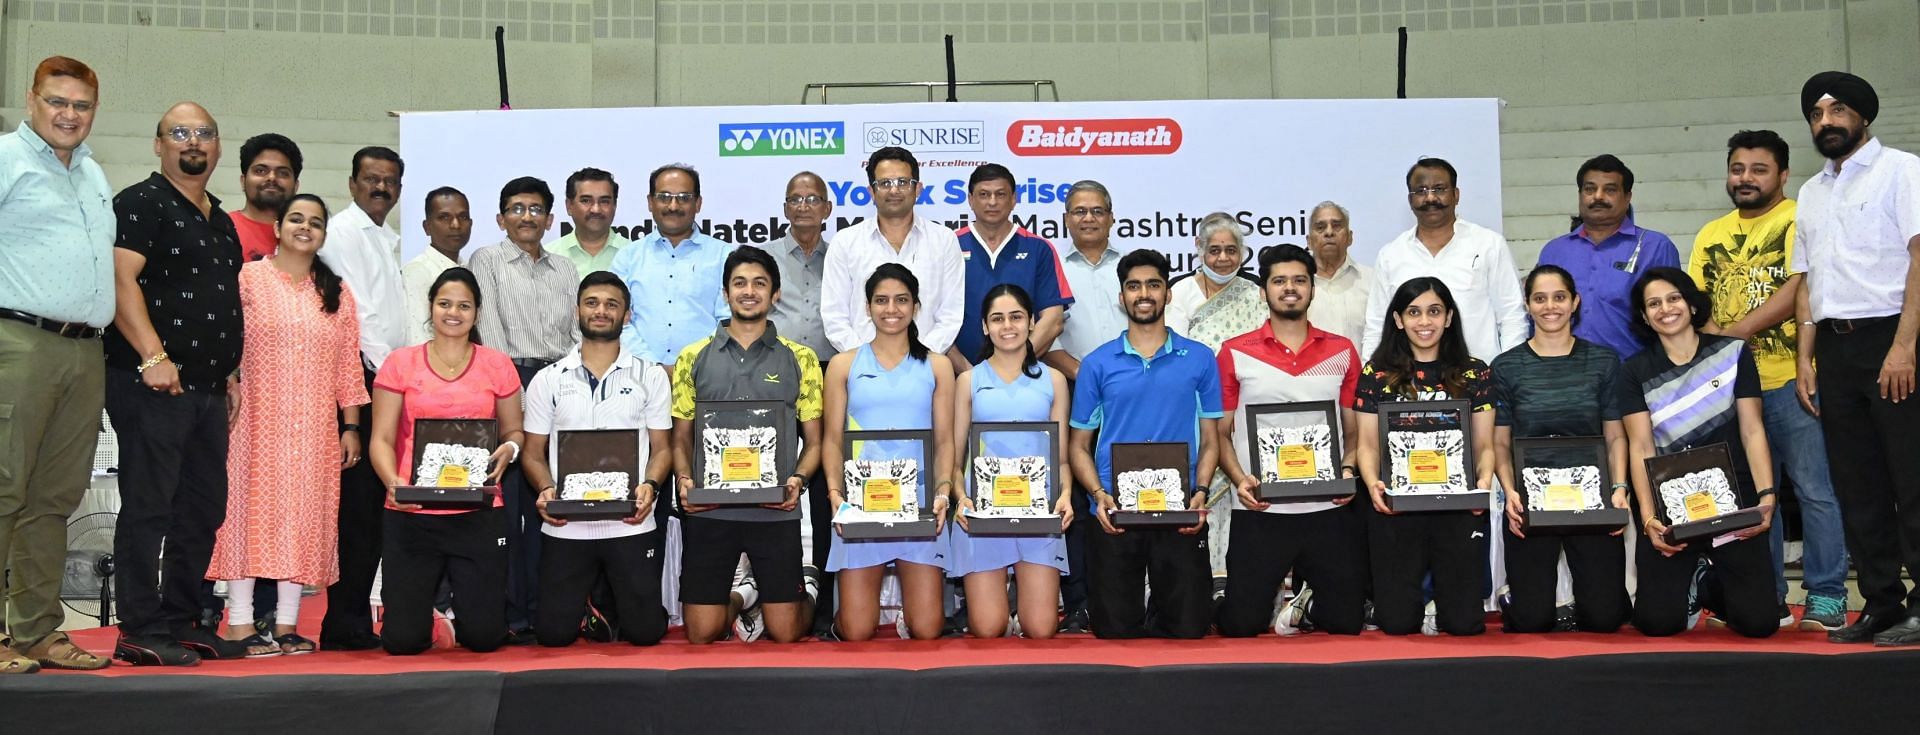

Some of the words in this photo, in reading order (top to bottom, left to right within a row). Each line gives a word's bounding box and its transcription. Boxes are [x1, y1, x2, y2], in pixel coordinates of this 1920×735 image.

[767, 128, 837, 150] YONEX
[890, 127, 981, 147] SUNRISE
[1017, 125, 1172, 153] Baidyanath
[828, 181, 936, 206] Yox
[943, 177, 1072, 205] Srise
